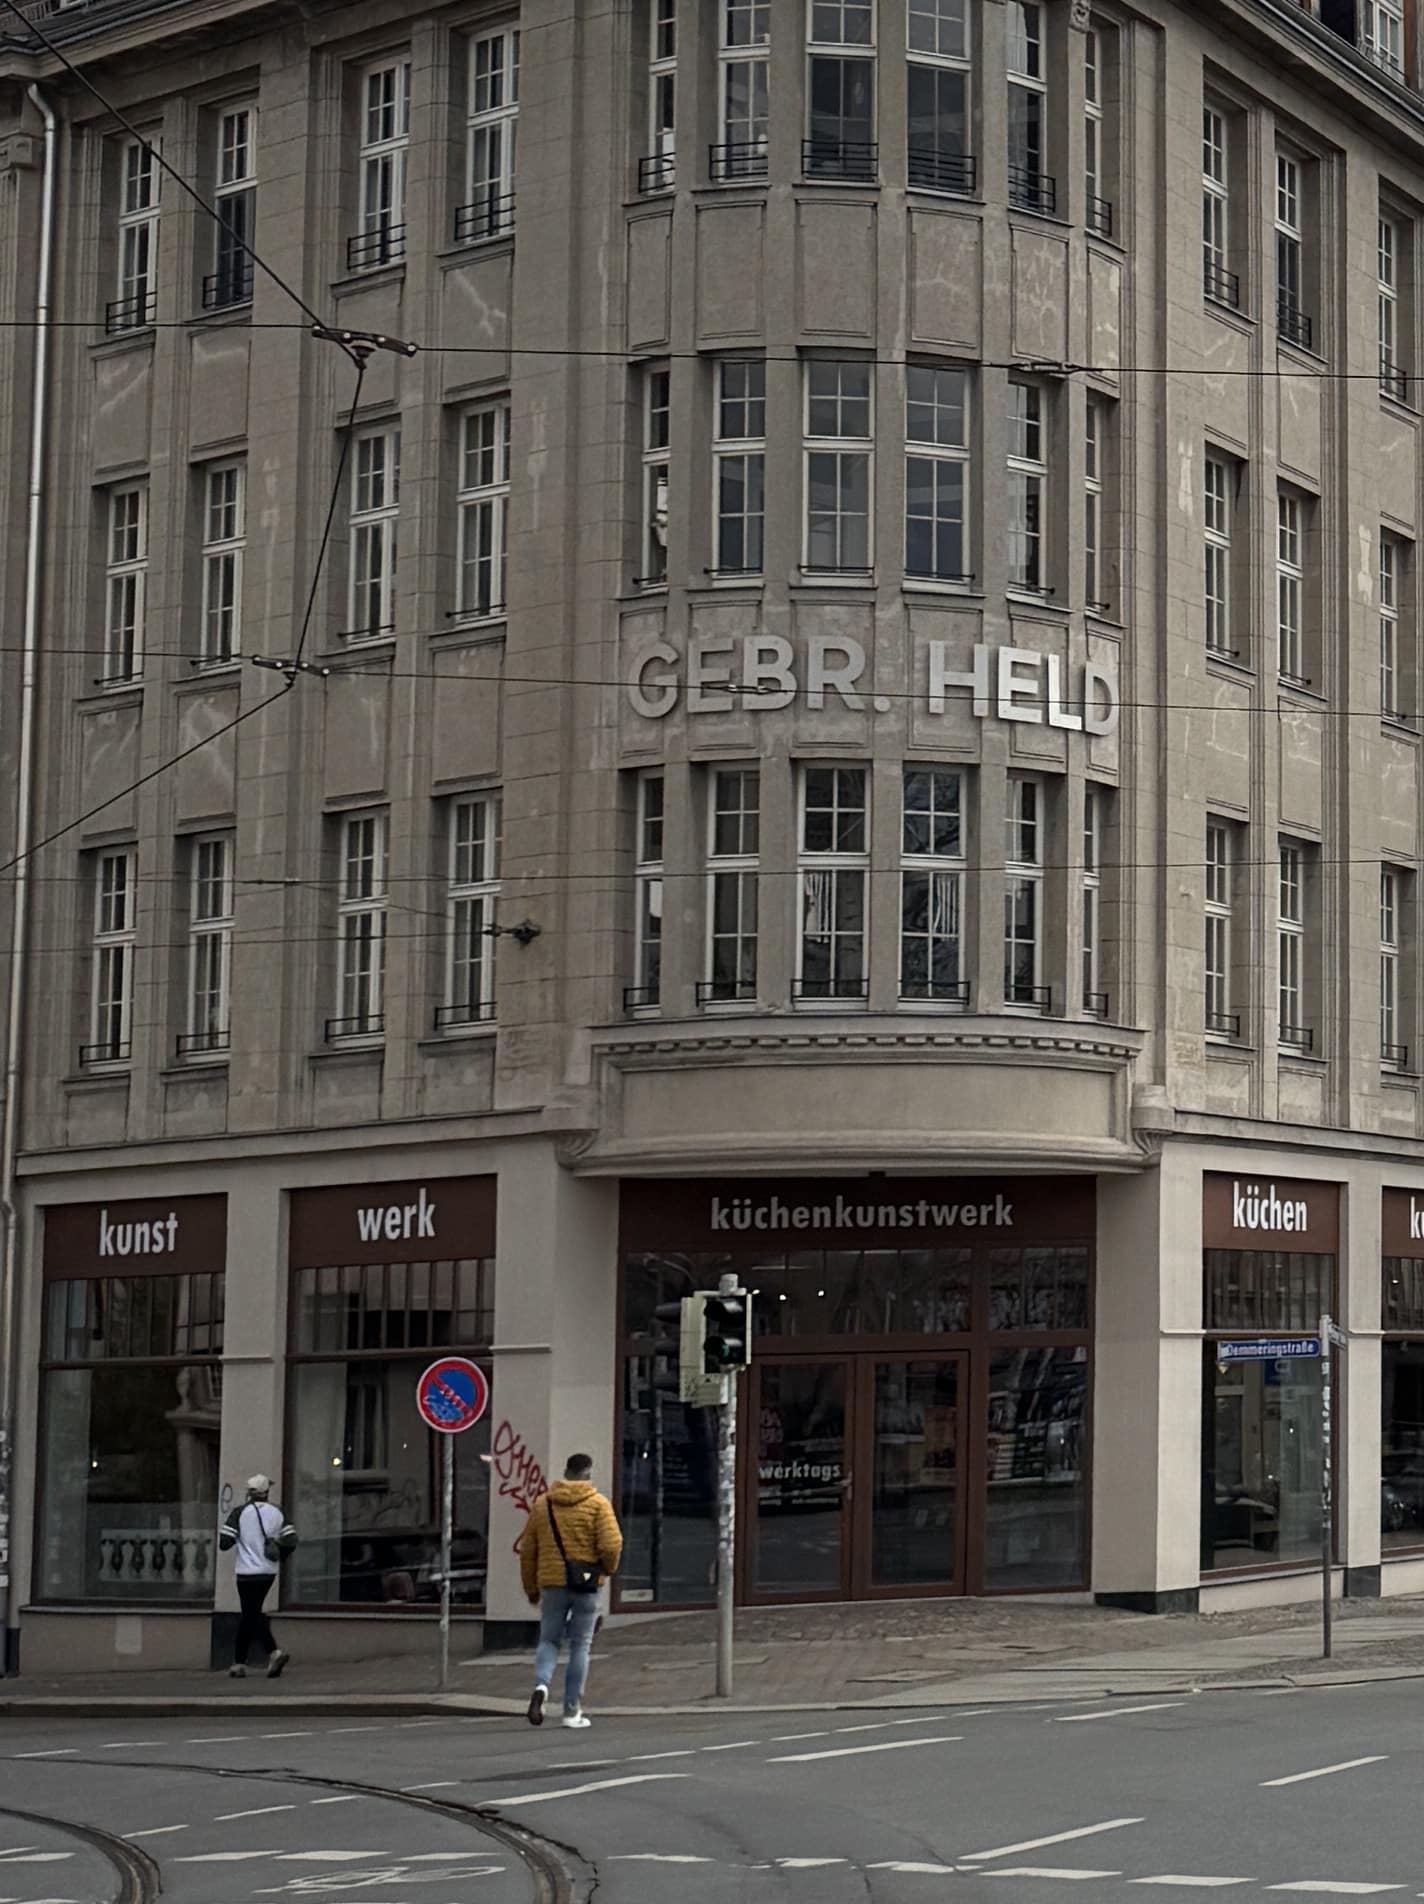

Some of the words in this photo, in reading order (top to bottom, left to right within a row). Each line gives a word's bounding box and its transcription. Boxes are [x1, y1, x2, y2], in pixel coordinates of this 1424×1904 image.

[627, 634, 891, 719] GEBR.
[928, 639, 1120, 736] HELD
[357, 1187, 437, 1242] werk
[711, 1193, 1014, 1230] küchenkunstwerk
[1233, 1181, 1308, 1232] küchen
[99, 1209, 179, 1257] kunst
[759, 1460, 841, 1482] werktags
